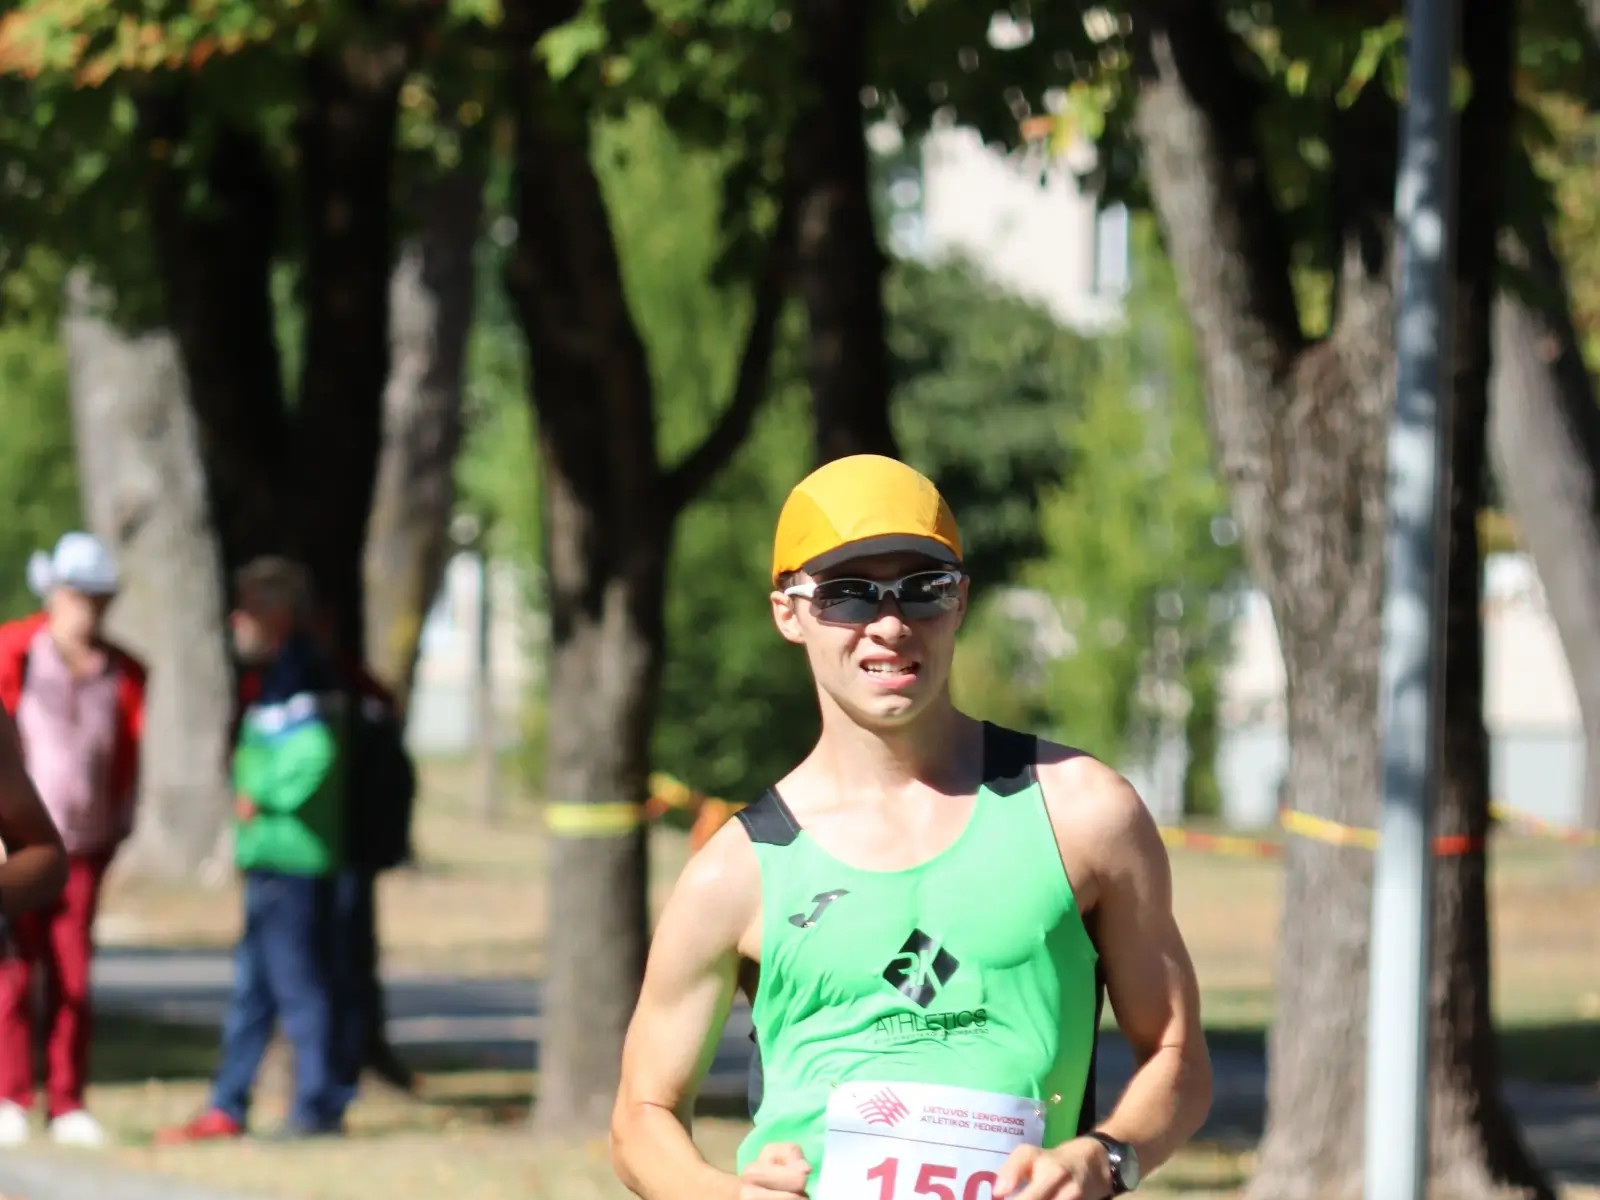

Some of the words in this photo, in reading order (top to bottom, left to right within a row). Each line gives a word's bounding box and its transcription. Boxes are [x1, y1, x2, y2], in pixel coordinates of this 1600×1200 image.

[876, 1008, 987, 1034] ATHLETICS
[922, 1105, 969, 1118] LIETUVOS
[920, 1115, 970, 1129] ATLETIKOS
